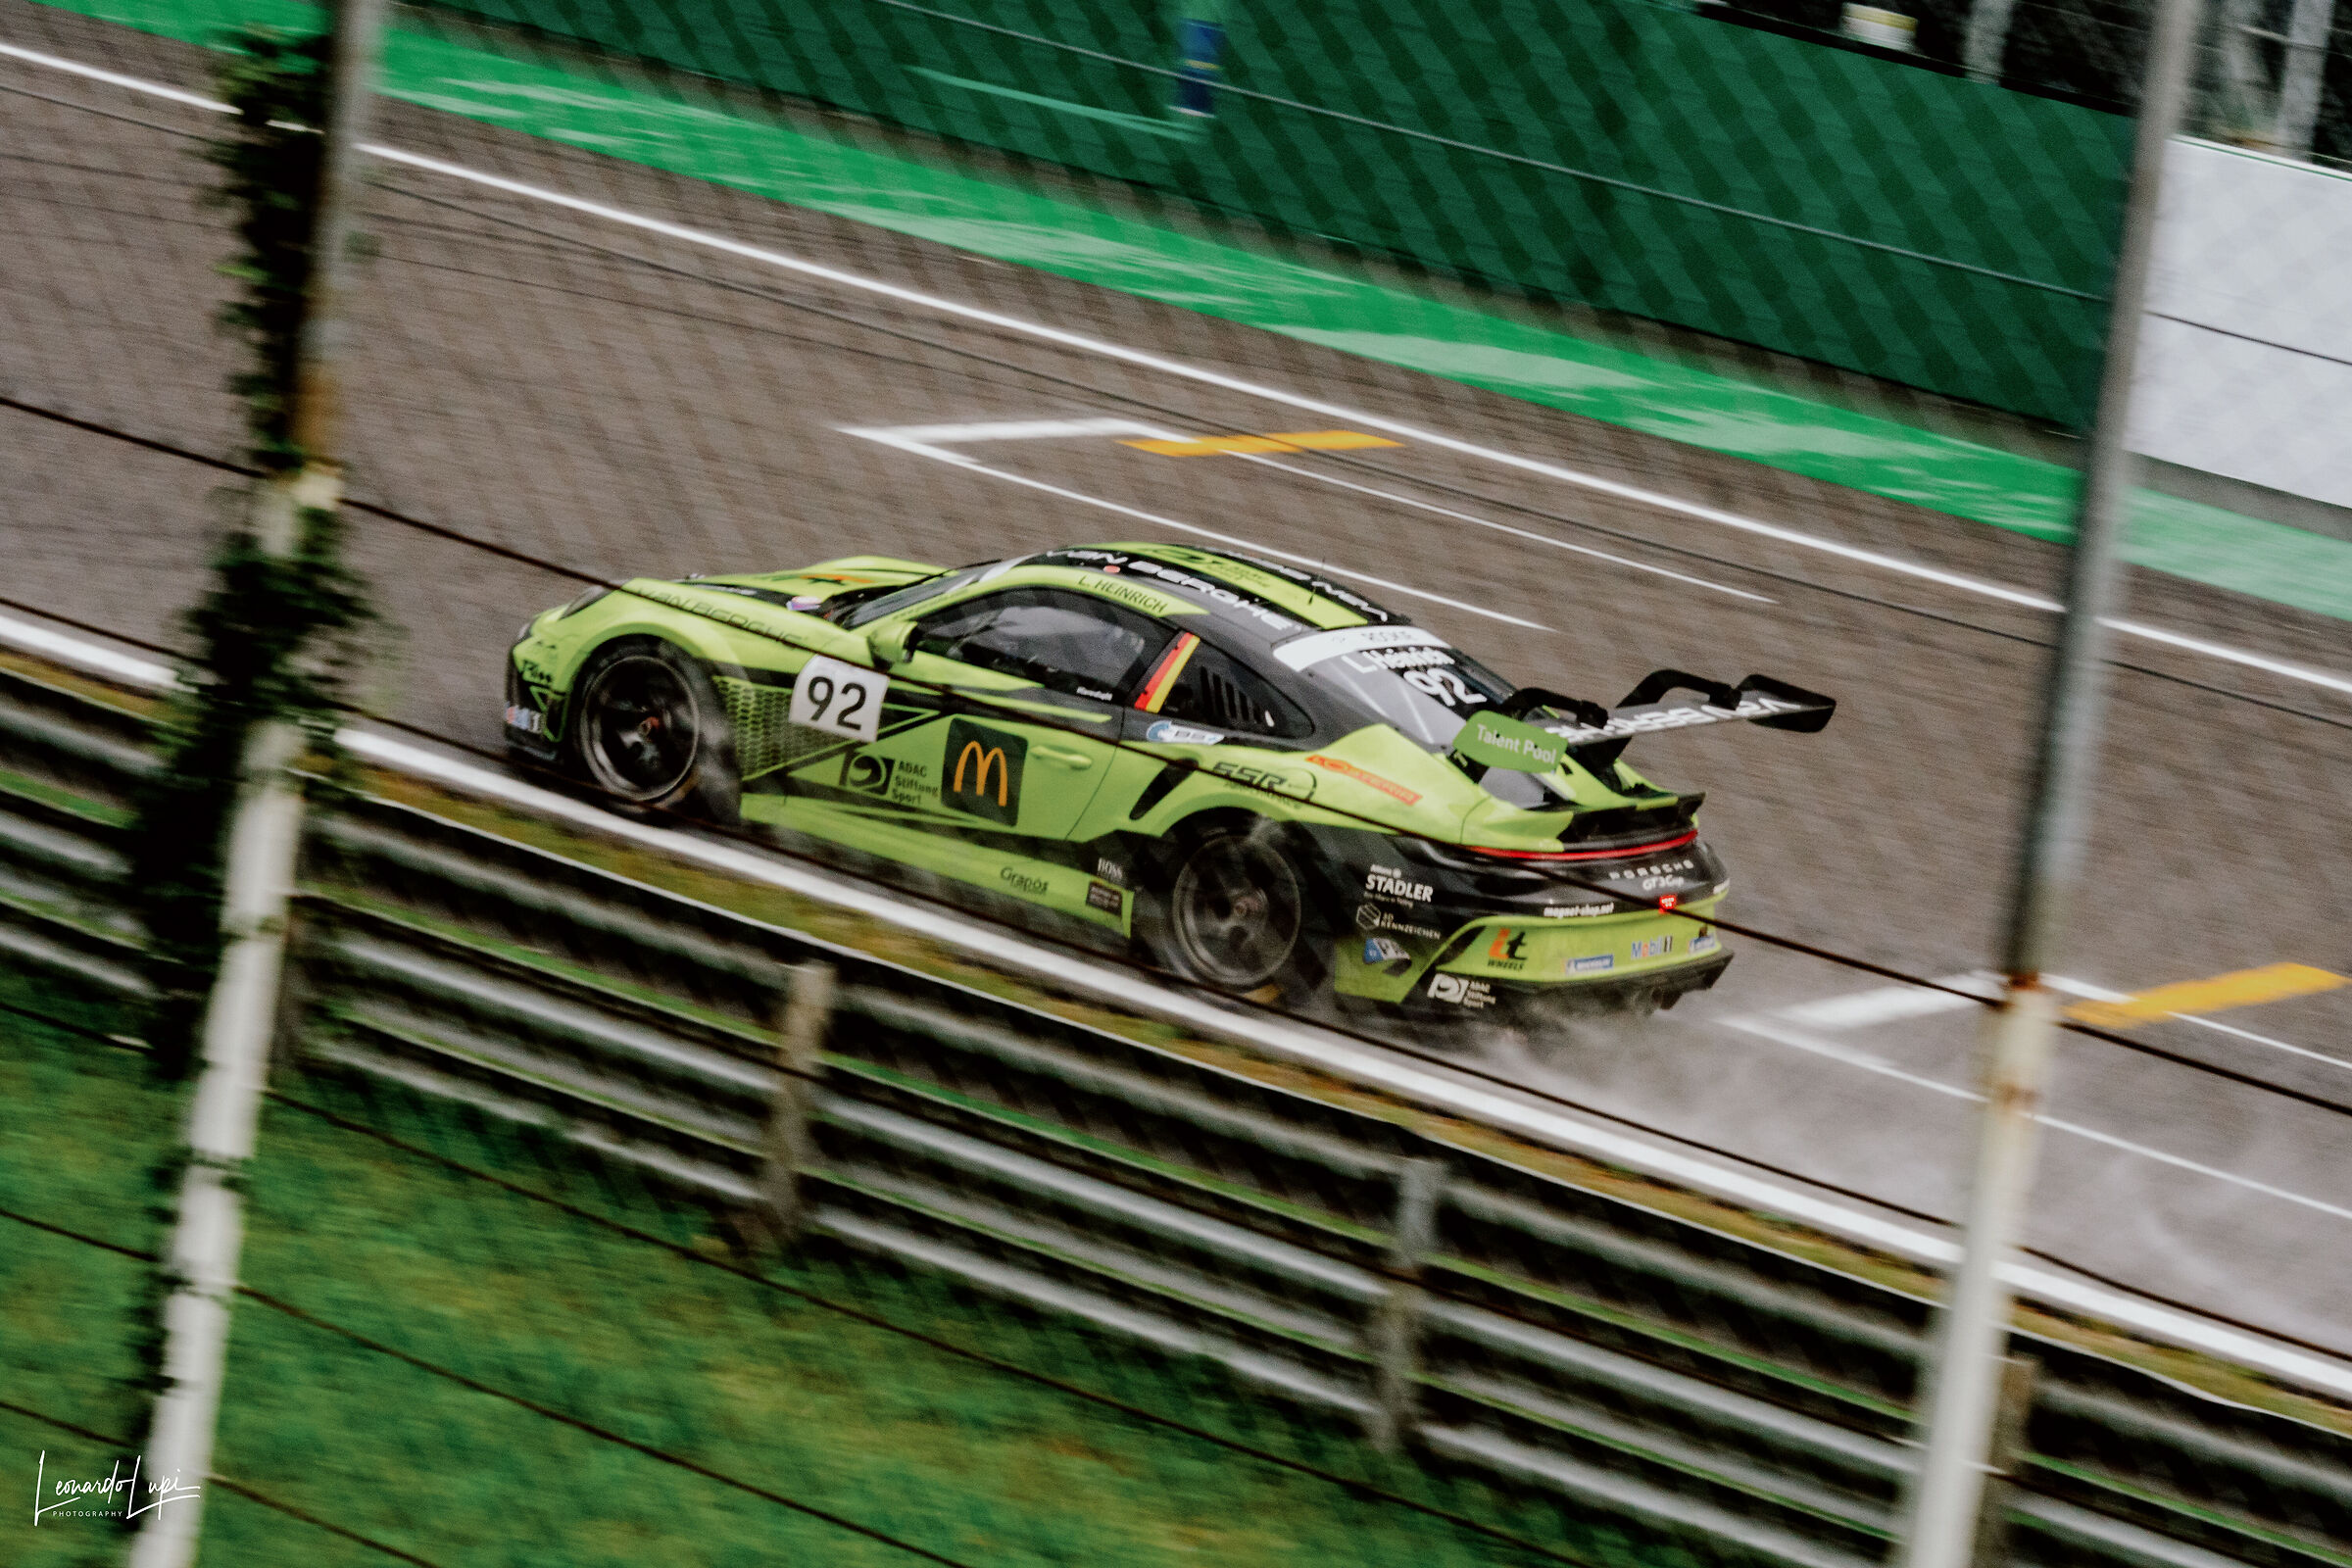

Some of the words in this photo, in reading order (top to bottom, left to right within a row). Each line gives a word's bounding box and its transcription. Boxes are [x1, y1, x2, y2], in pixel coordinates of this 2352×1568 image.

[1095, 579, 1167, 612] HEINRICH
[1403, 667, 1489, 708] 92
[808, 676, 866, 730] 92
[1478, 723, 1521, 754] Talent
[1523, 739, 1557, 764] Pool
[898, 760, 927, 778] ADAC
[892, 788, 922, 805] Sport
[895, 774, 940, 799] Stiftung
[1365, 874, 1434, 903] STADLER
[1631, 937, 1663, 959] Mobil
